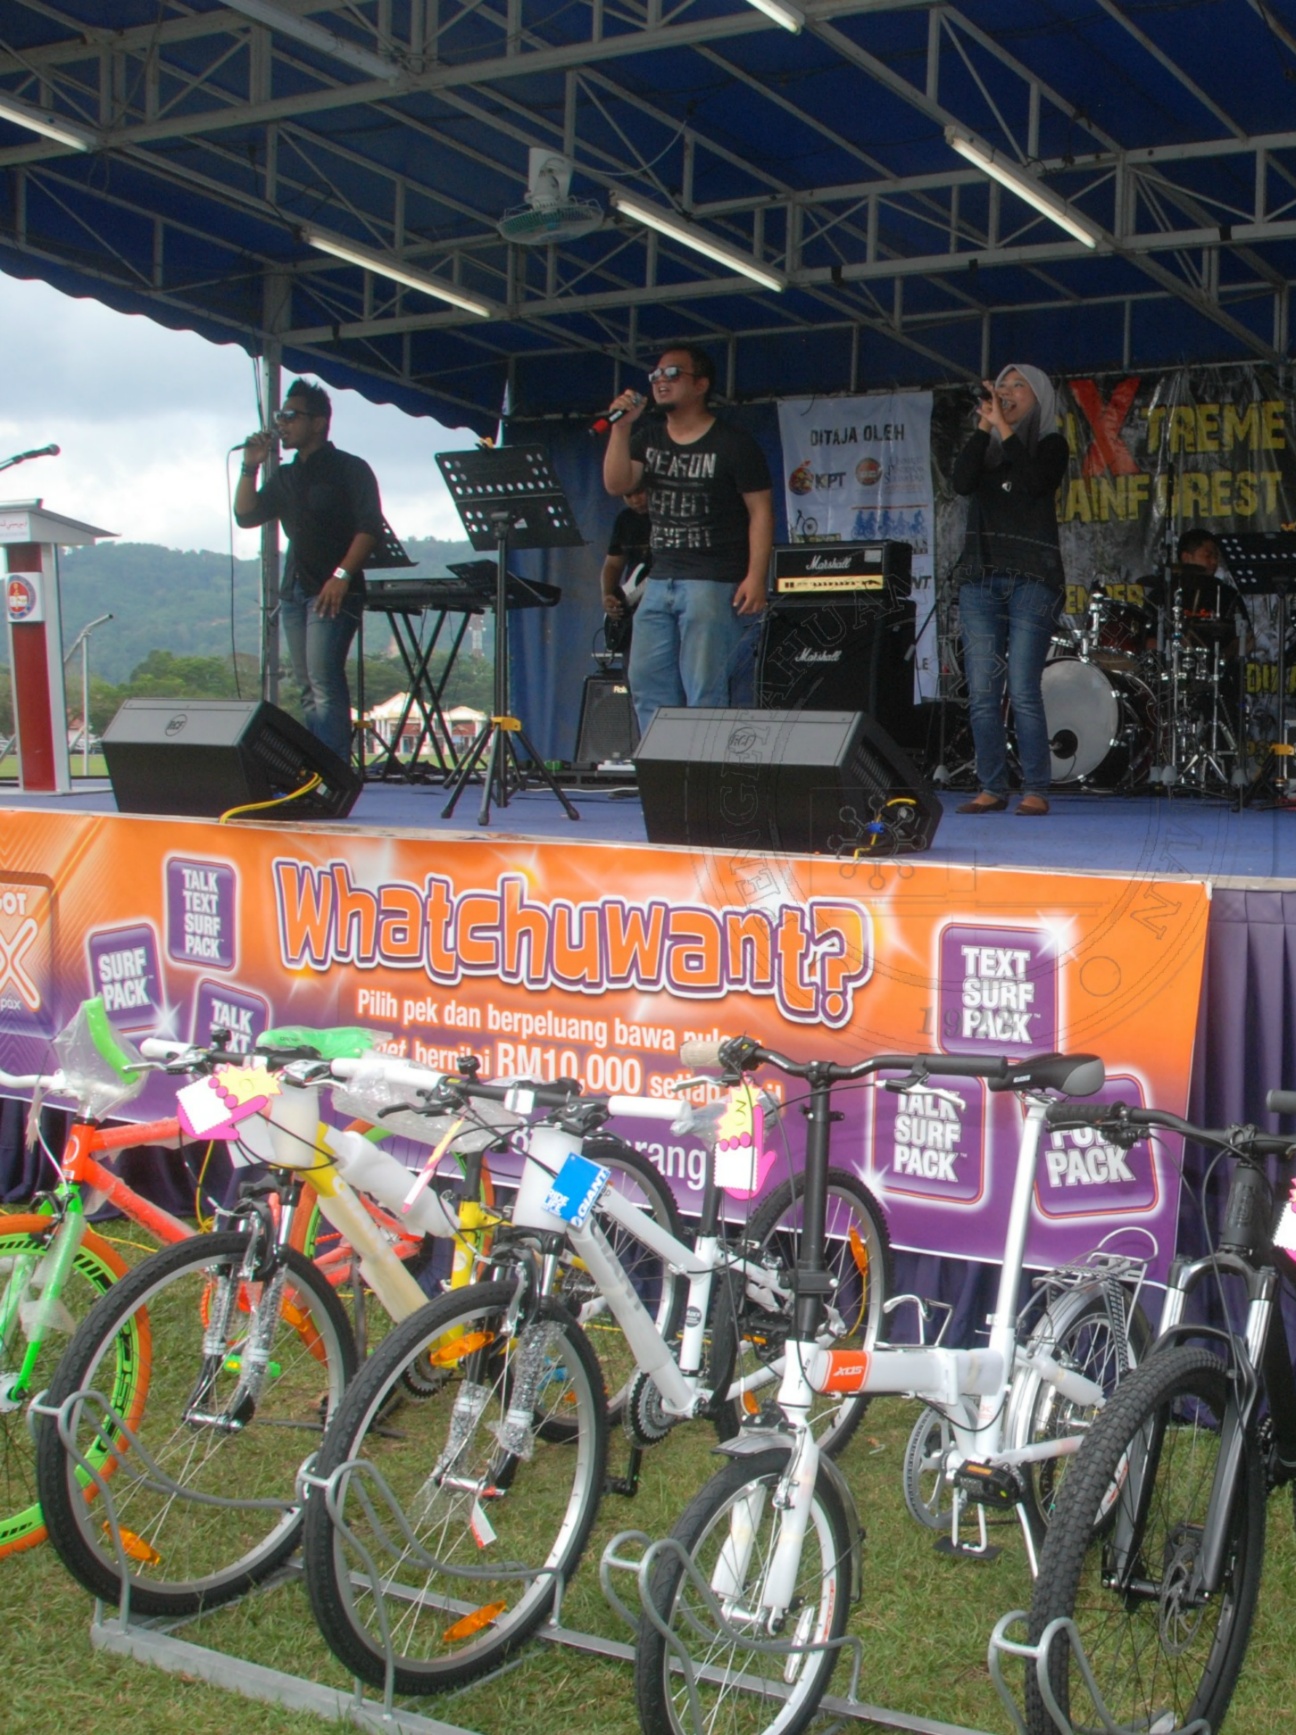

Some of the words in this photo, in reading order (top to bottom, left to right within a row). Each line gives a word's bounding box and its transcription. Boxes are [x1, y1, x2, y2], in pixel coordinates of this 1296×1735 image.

[810, 426, 858, 446] DITAJA
[863, 423, 905, 442] OLEH
[806, 555, 852, 571] Marshall
[795, 648, 842, 663] Marshall
[182, 869, 219, 893] TALK
[182, 890, 219, 915] TEXT
[184, 913, 221, 938] SURF
[272, 857, 873, 1028] Whatchuwant?
[98, 946, 147, 983] SURF
[961, 944, 1031, 980] TEXT
[962, 977, 1035, 1012] SURF
[211, 998, 254, 1036] TALK
[357, 988, 398, 1019] Pilih
[403, 997, 439, 1026] pek
[444, 1004, 481, 1027] dan
[487, 1004, 608, 1048] berpeluang
[614, 1018, 675, 1050] bawa
[496, 1042, 642, 1096] RM10,000
[893, 1114, 961, 1151] SURF
[624, 1137, 707, 1191] rang
[577, 1169, 611, 1218] GIANT
